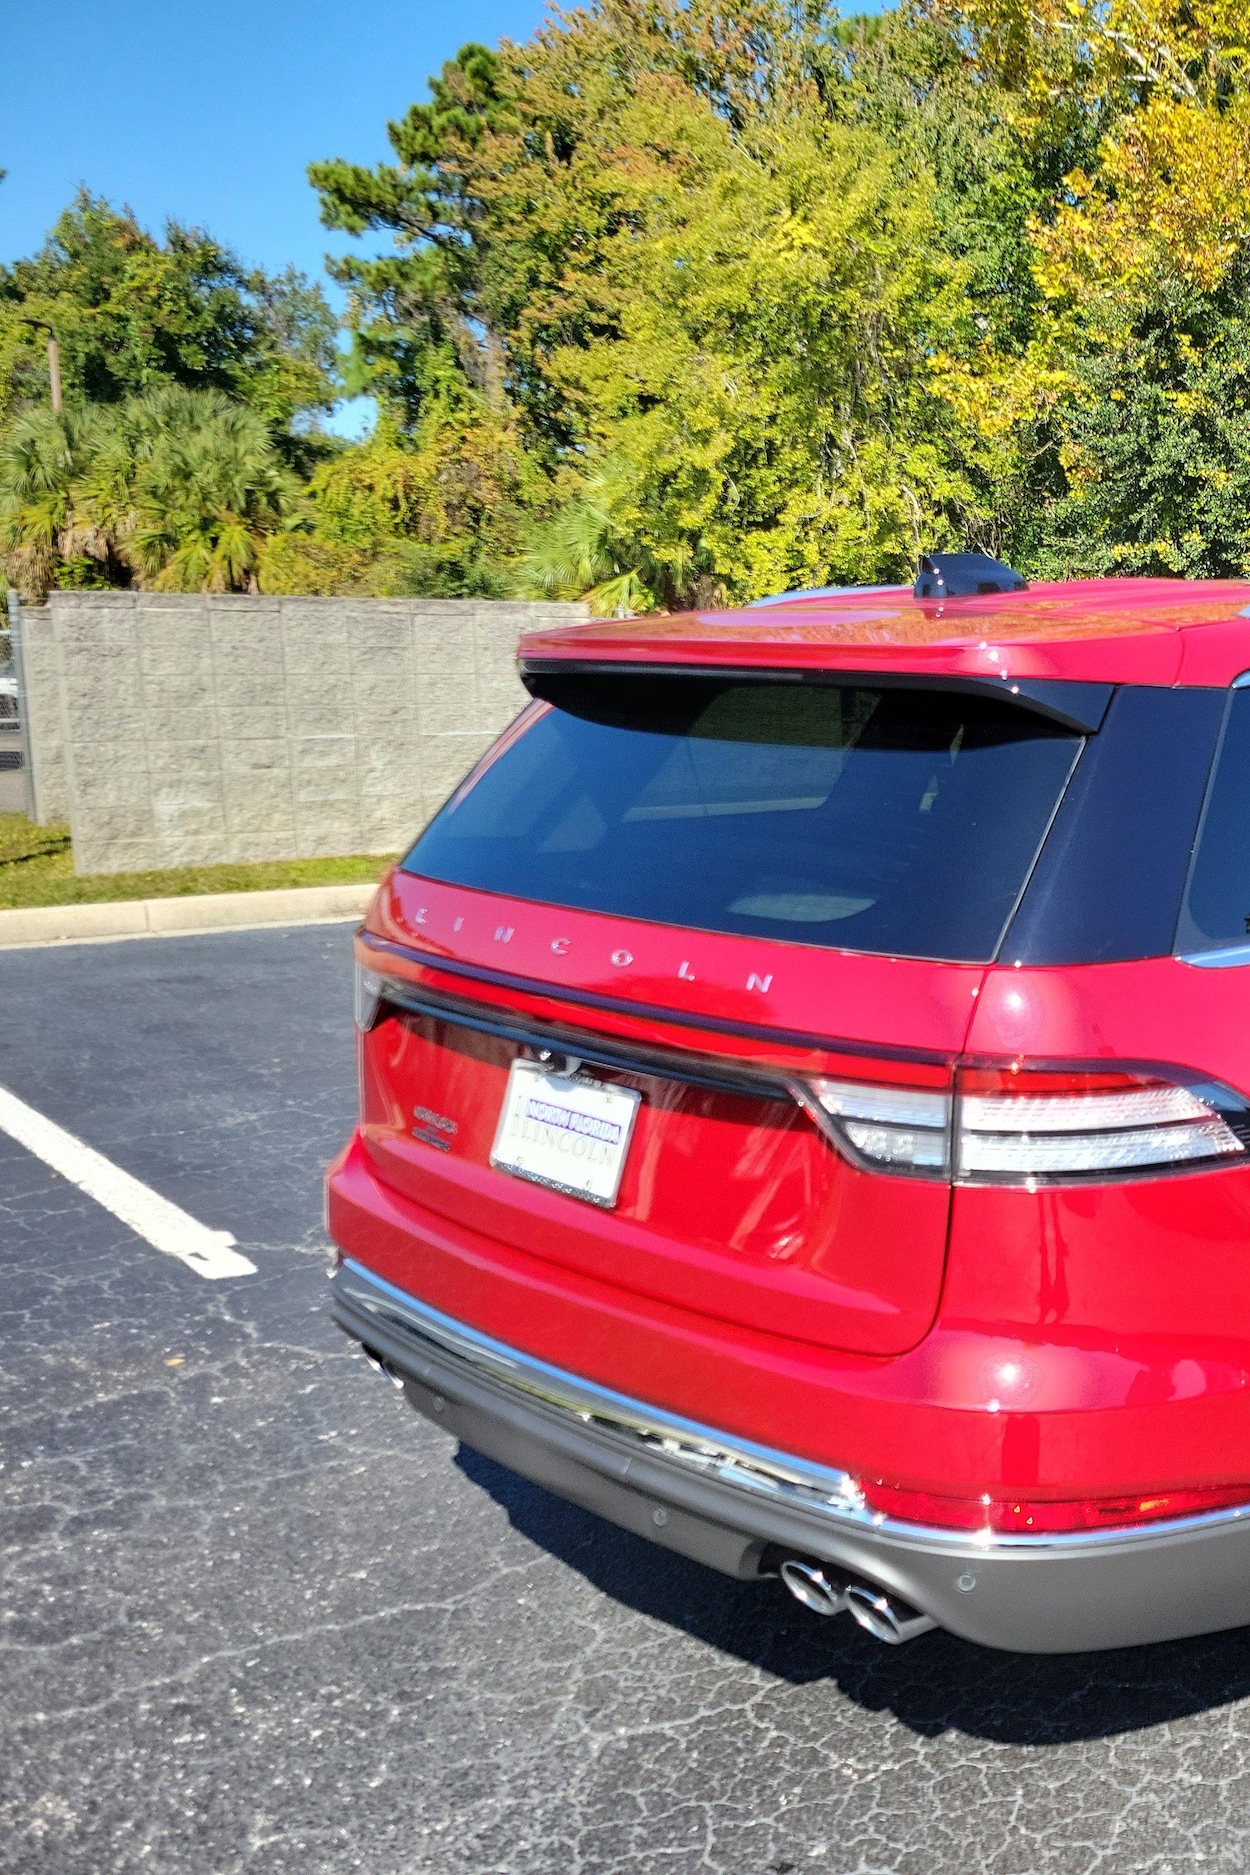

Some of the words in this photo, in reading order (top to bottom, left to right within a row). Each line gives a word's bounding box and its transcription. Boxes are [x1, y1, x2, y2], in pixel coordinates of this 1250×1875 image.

[414, 907, 774, 993] LINCOLN
[521, 1121, 617, 1167] LINCOLN
[526, 1100, 573, 1129] NORTH
[568, 1112, 620, 1144] FLORIDA
